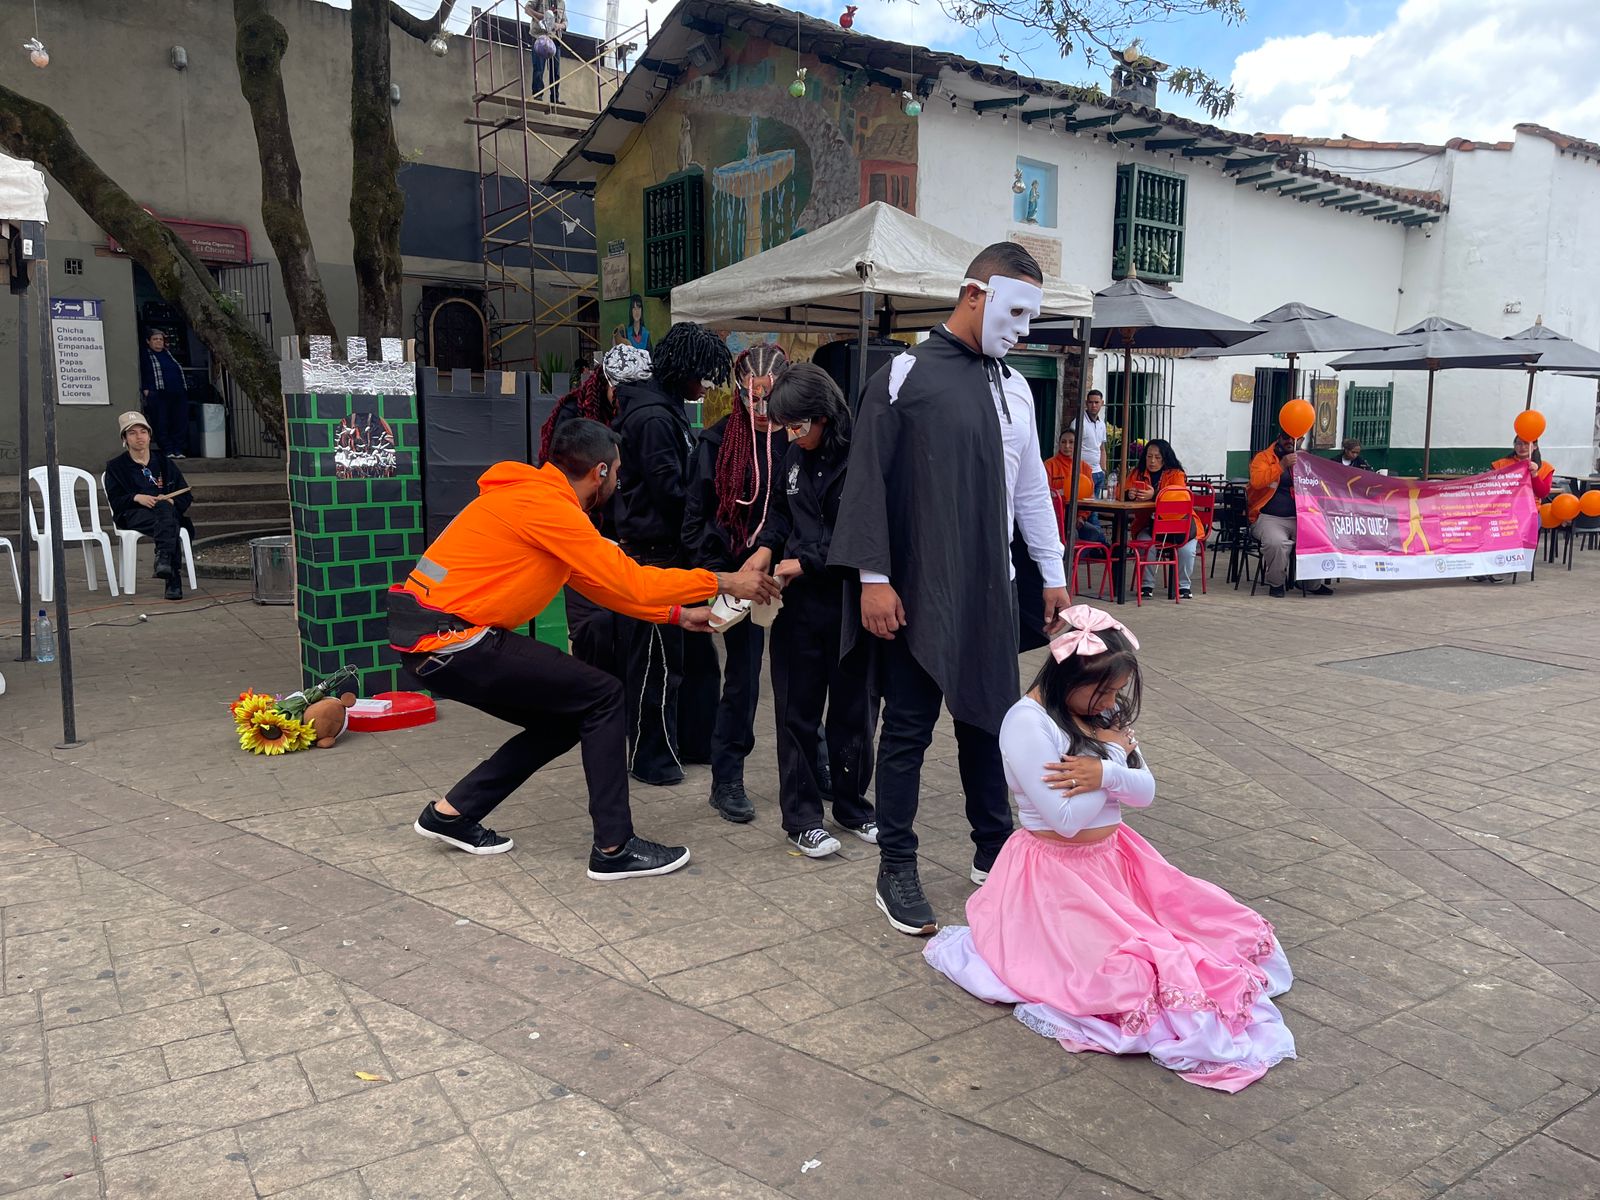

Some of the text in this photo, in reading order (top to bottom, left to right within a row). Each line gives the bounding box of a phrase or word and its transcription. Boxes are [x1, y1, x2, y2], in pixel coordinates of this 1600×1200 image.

[57, 334, 96, 342] Gaseosas
[58, 343, 103, 351] Empanadas
[59, 350, 78, 358] Tinto
[59, 358, 83, 366] Papas
[61, 374, 101, 382] Cigarrillos
[1298, 476, 1319, 486] Trabajo
[1368, 518, 1389, 536] QUE?
[1506, 554, 1525, 562] USAI
